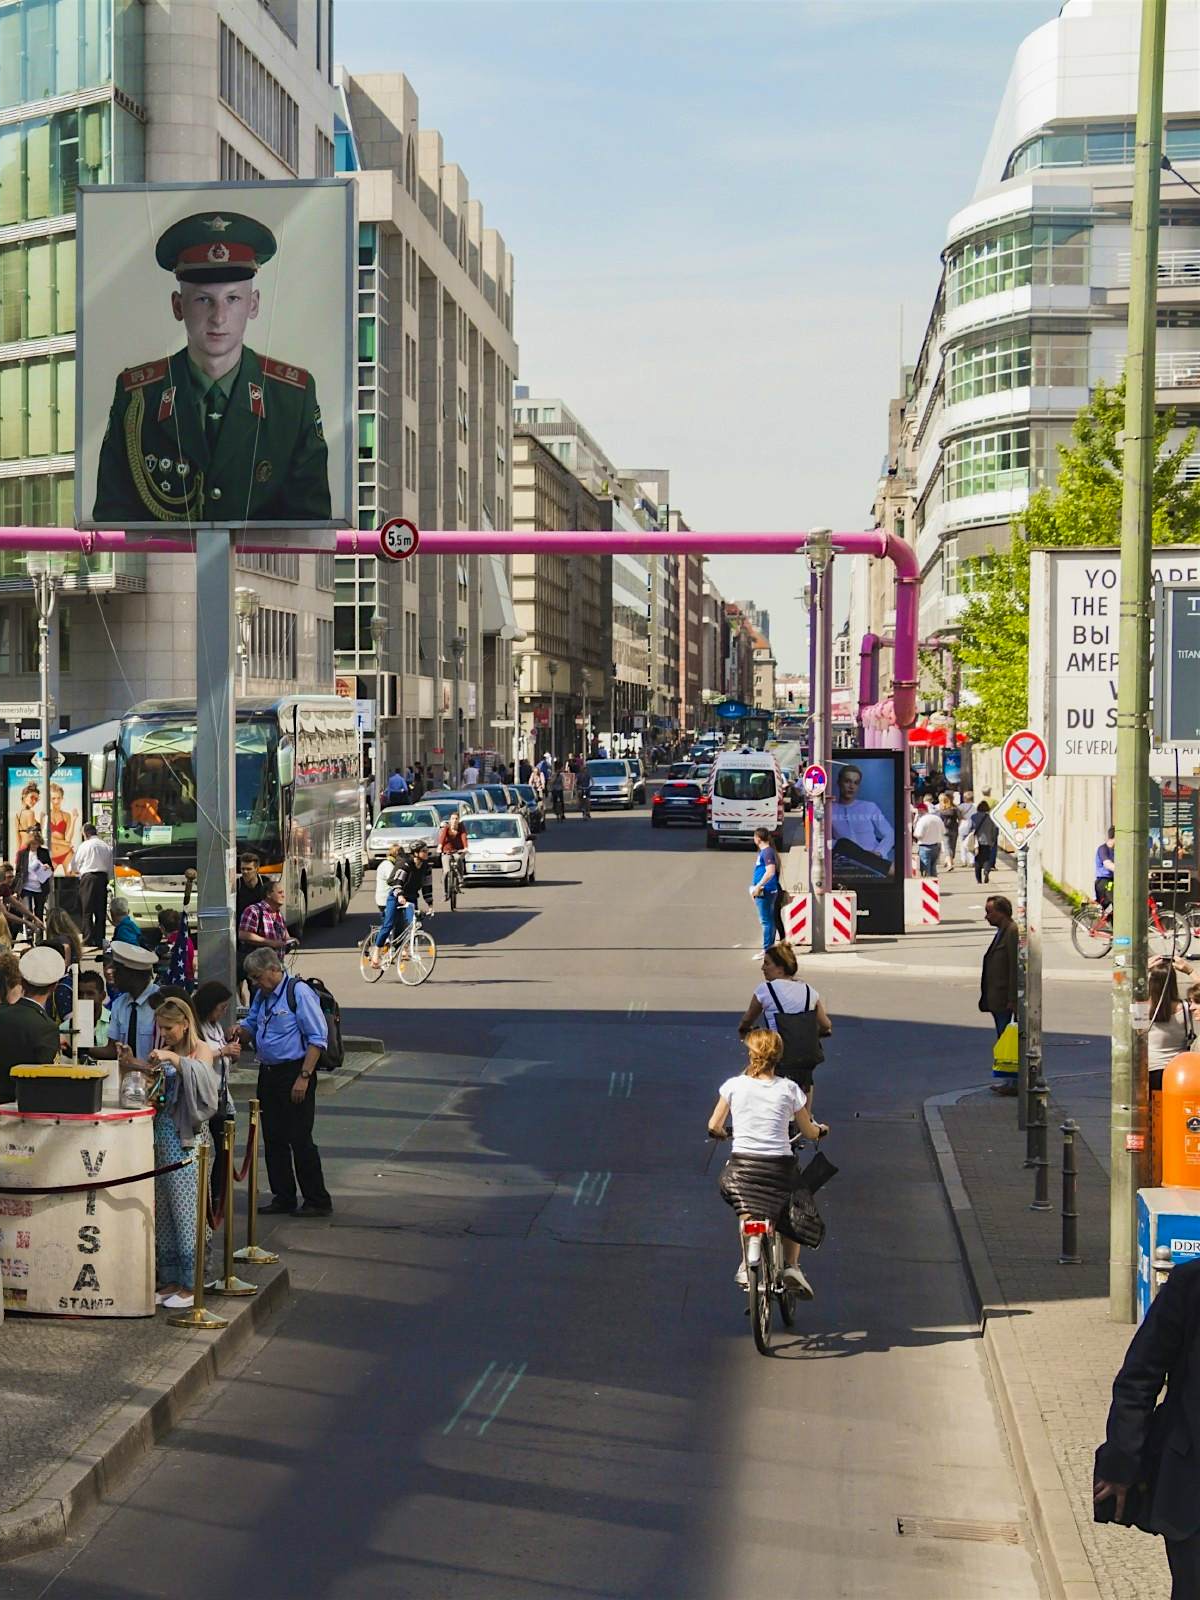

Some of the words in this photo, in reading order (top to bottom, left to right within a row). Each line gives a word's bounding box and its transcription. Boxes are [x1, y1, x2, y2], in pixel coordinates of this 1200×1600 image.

[403, 537, 412, 546] m
[1085, 569, 1117, 589] YO
[1071, 596, 1108, 617] THE
[1066, 652, 1119, 672] АМЕР
[1067, 708, 1094, 729] DU
[1105, 707, 1118, 729] S
[1086, 739, 1118, 755] VERL
[58, 1296, 115, 1311] STAMP
